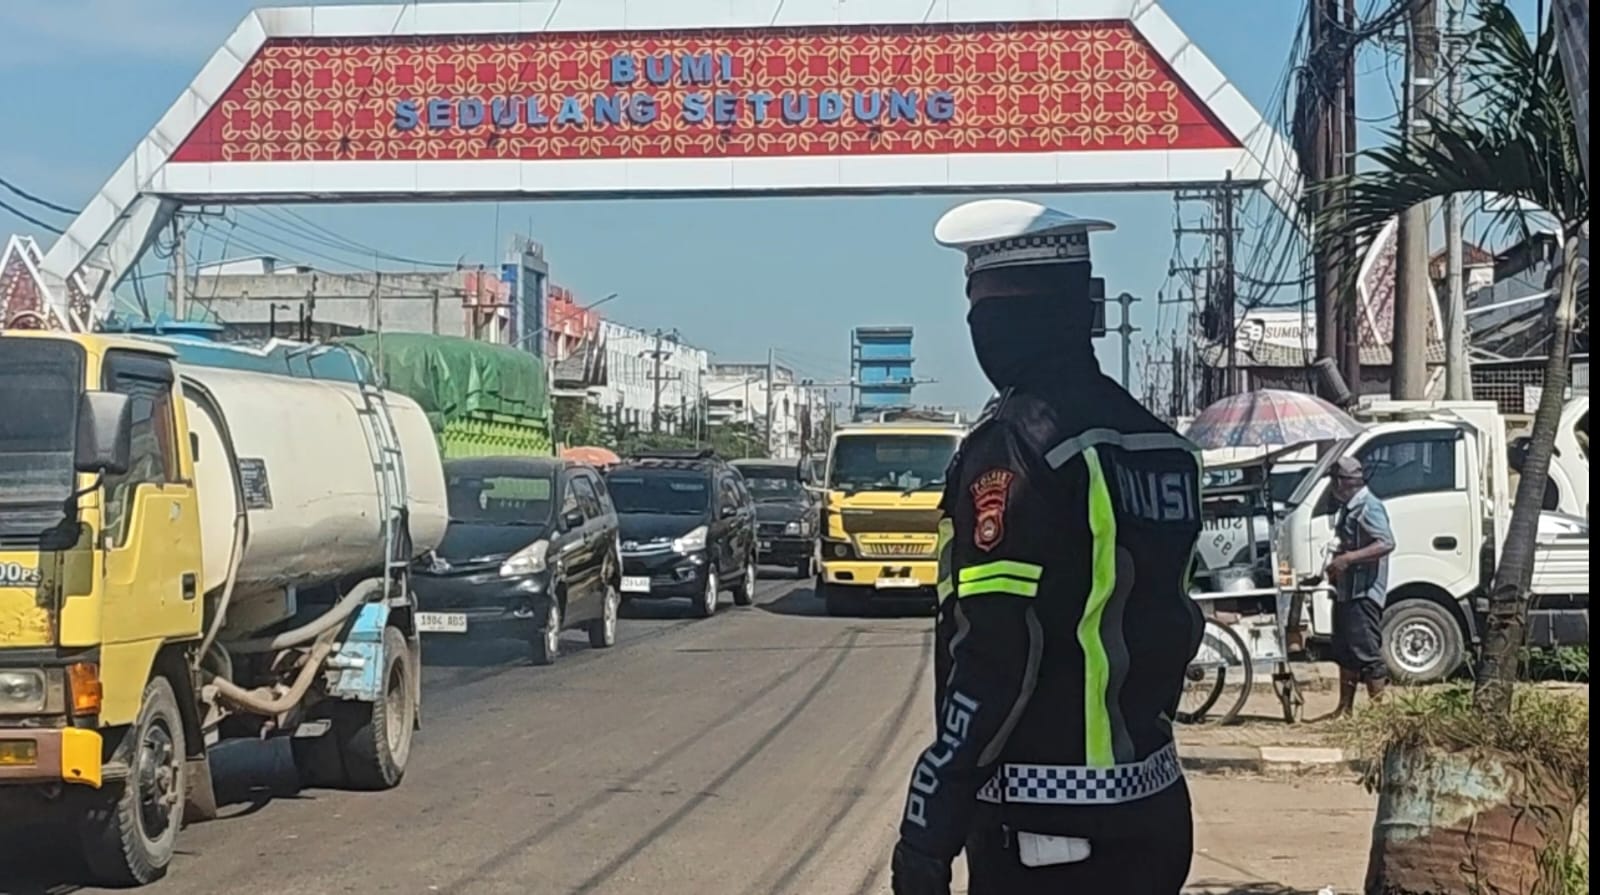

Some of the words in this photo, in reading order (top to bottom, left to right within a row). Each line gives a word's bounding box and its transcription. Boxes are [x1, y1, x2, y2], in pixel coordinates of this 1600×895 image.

[610, 53, 733, 85] BUMI
[394, 94, 657, 129] SEDULANG
[682, 91, 956, 124] SETUDUNG
[907, 690, 979, 827] POLISI
